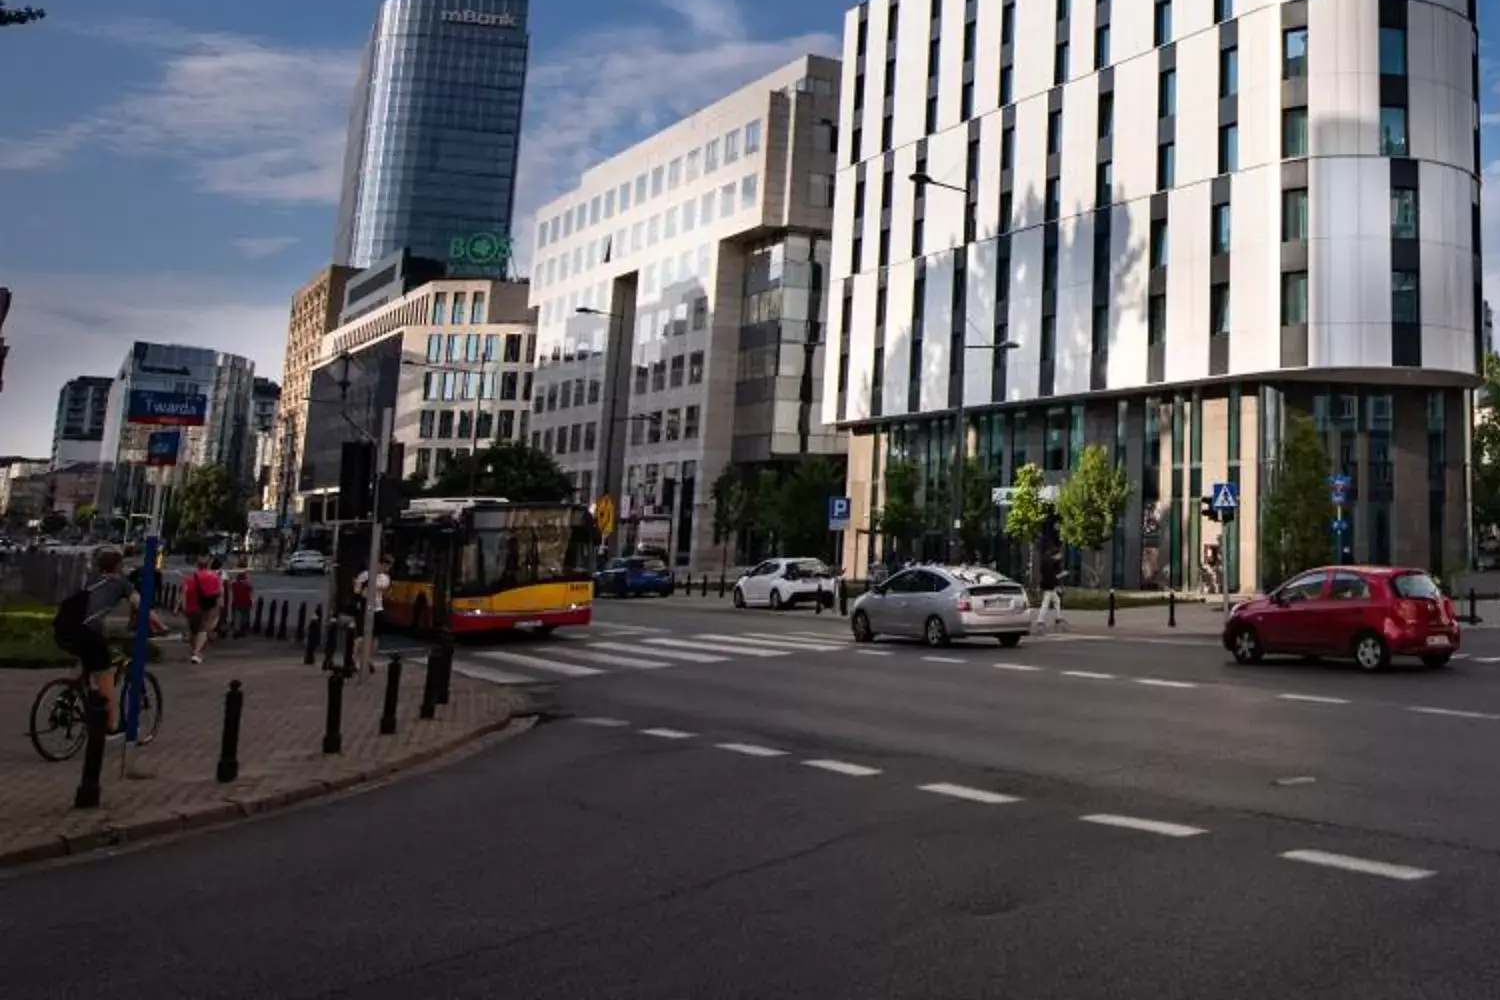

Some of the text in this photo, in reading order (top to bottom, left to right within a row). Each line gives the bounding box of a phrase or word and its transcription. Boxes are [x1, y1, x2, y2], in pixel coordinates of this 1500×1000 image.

[441, 9, 518, 27] mBank
[145, 397, 197, 415] Twarda
[834, 499, 847, 516] P
